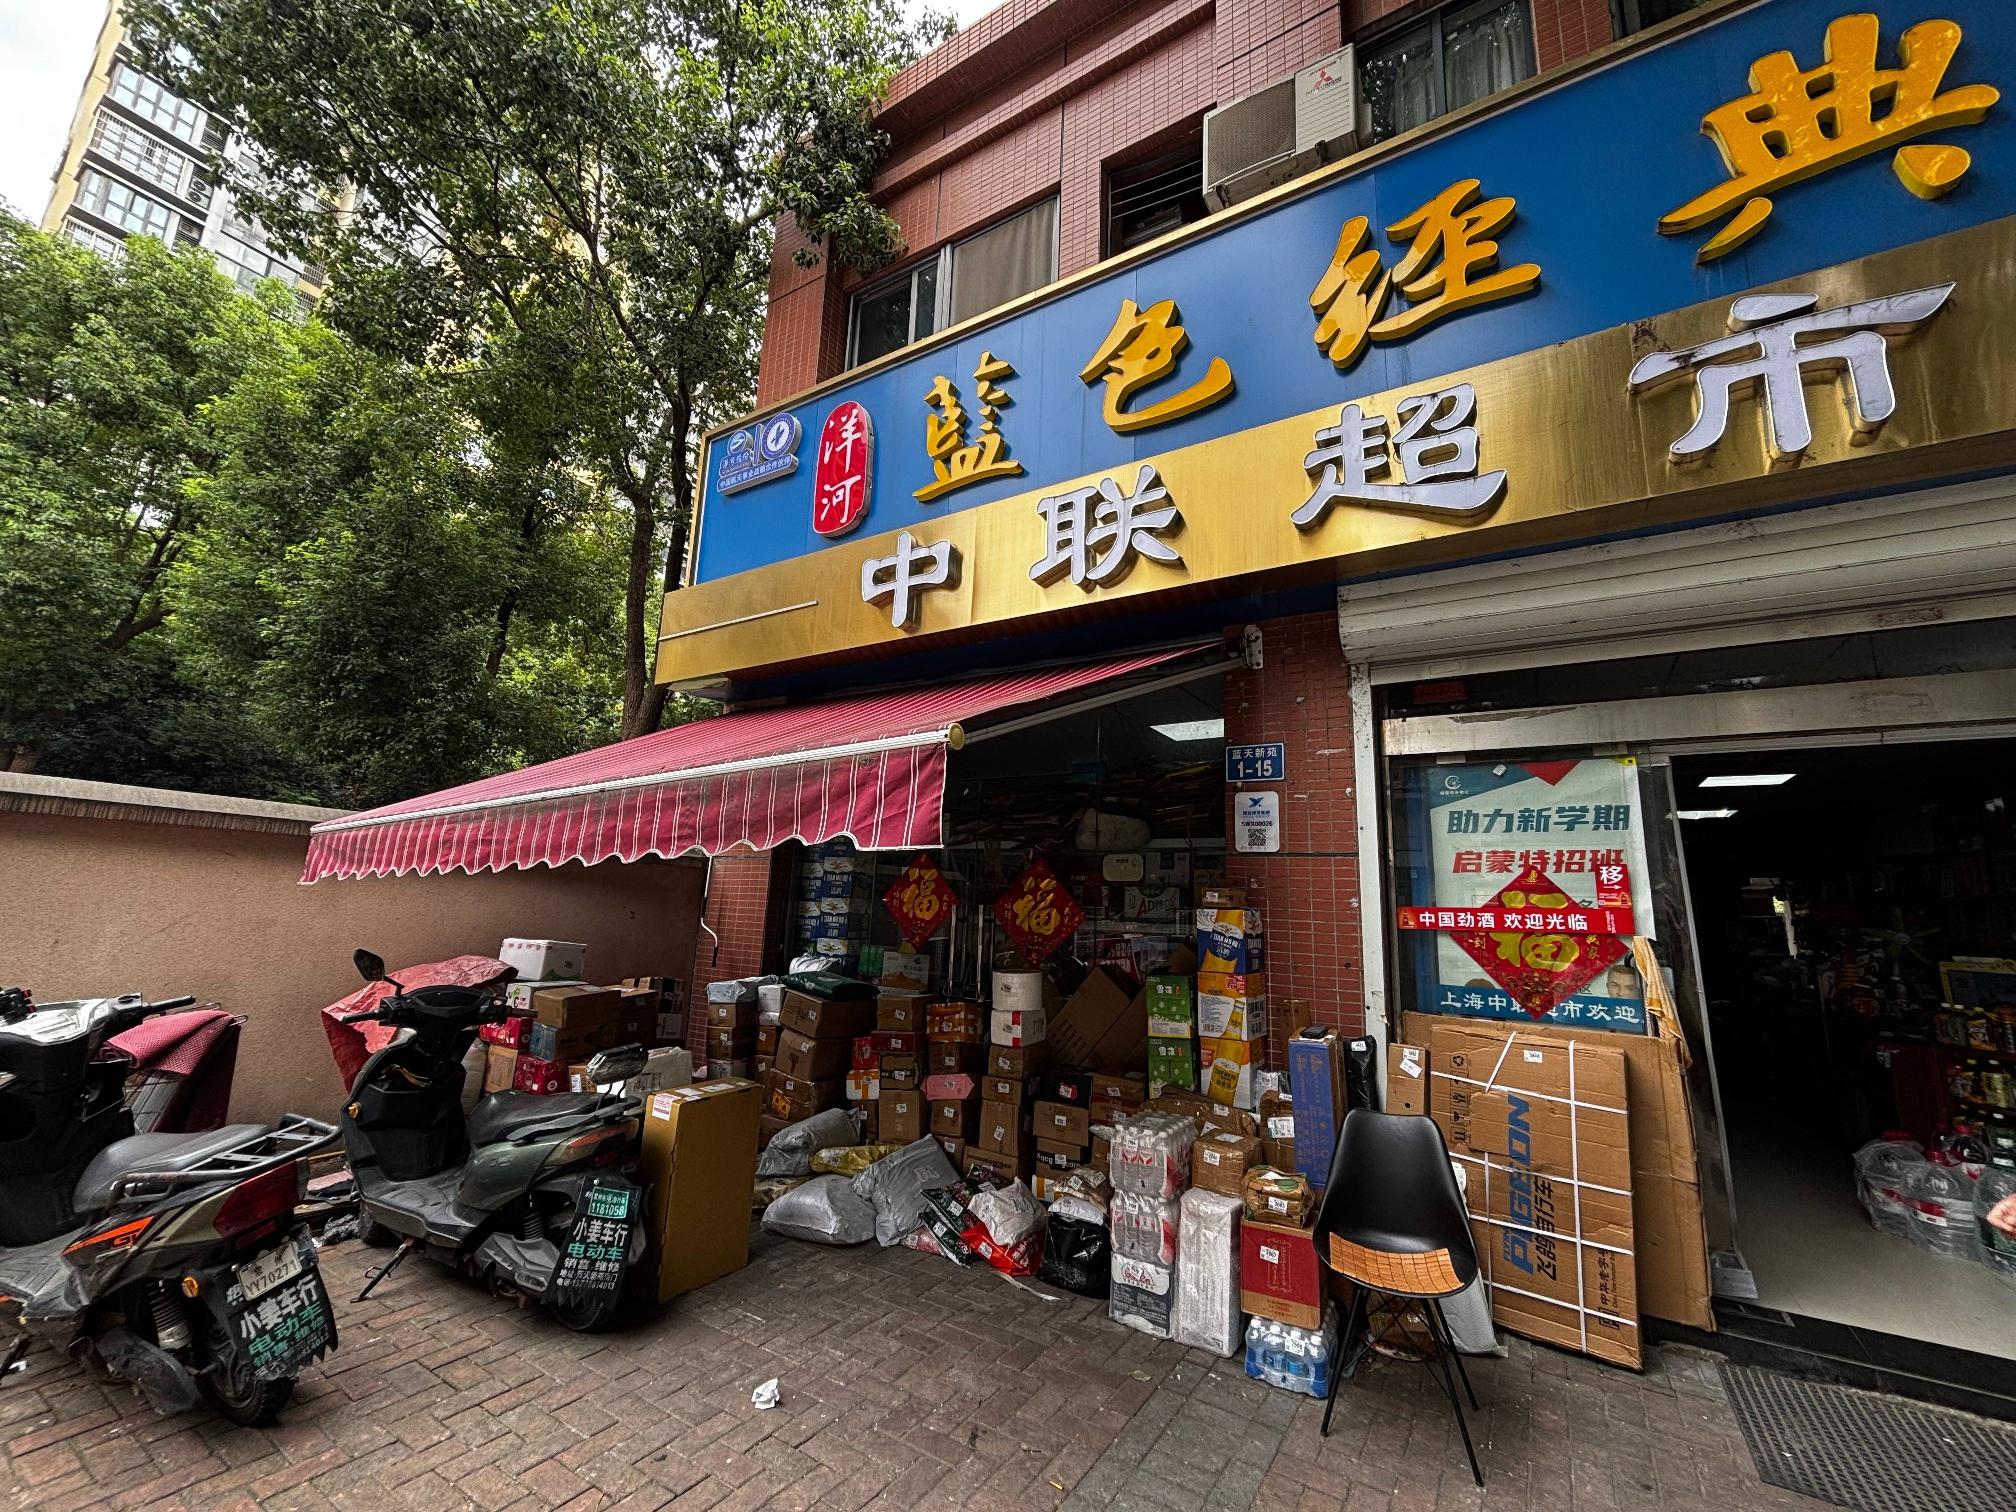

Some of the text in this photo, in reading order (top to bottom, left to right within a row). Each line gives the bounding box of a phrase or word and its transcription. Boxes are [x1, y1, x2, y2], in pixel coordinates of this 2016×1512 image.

[819, 407, 864, 526] 洋河
[860, 282, 1957, 630] 中联超市
[1232, 747, 1278, 760] 蓝天新苑
[1237, 759, 1273, 778] 1-15
[1447, 804, 1631, 834] 助力新学期
[1452, 848, 1625, 874] 启蒙特招班
[1600, 865, 1624, 885] 移
[901, 867, 941, 920] 福
[1014, 876, 1061, 935] 福
[1419, 912, 1496, 929] 中国劲酒
[1503, 913, 1588, 931] 欢迎光临
[1440, 991, 1640, 1024] 上海中联市欢迎
[1507, 1093, 1534, 1275] PIGEON
[591, 1202, 625, 1216] 1181058
[572, 1217, 629, 1247] 小姜车行
[1533, 1176, 1558, 1281] 飞鸽自行车
[567, 1241, 625, 1262] 电动车
[245, 1259, 298, 1296] YY70271
[240, 1274, 319, 1340] 小姜车行
[247, 1301, 324, 1356] 电动车
